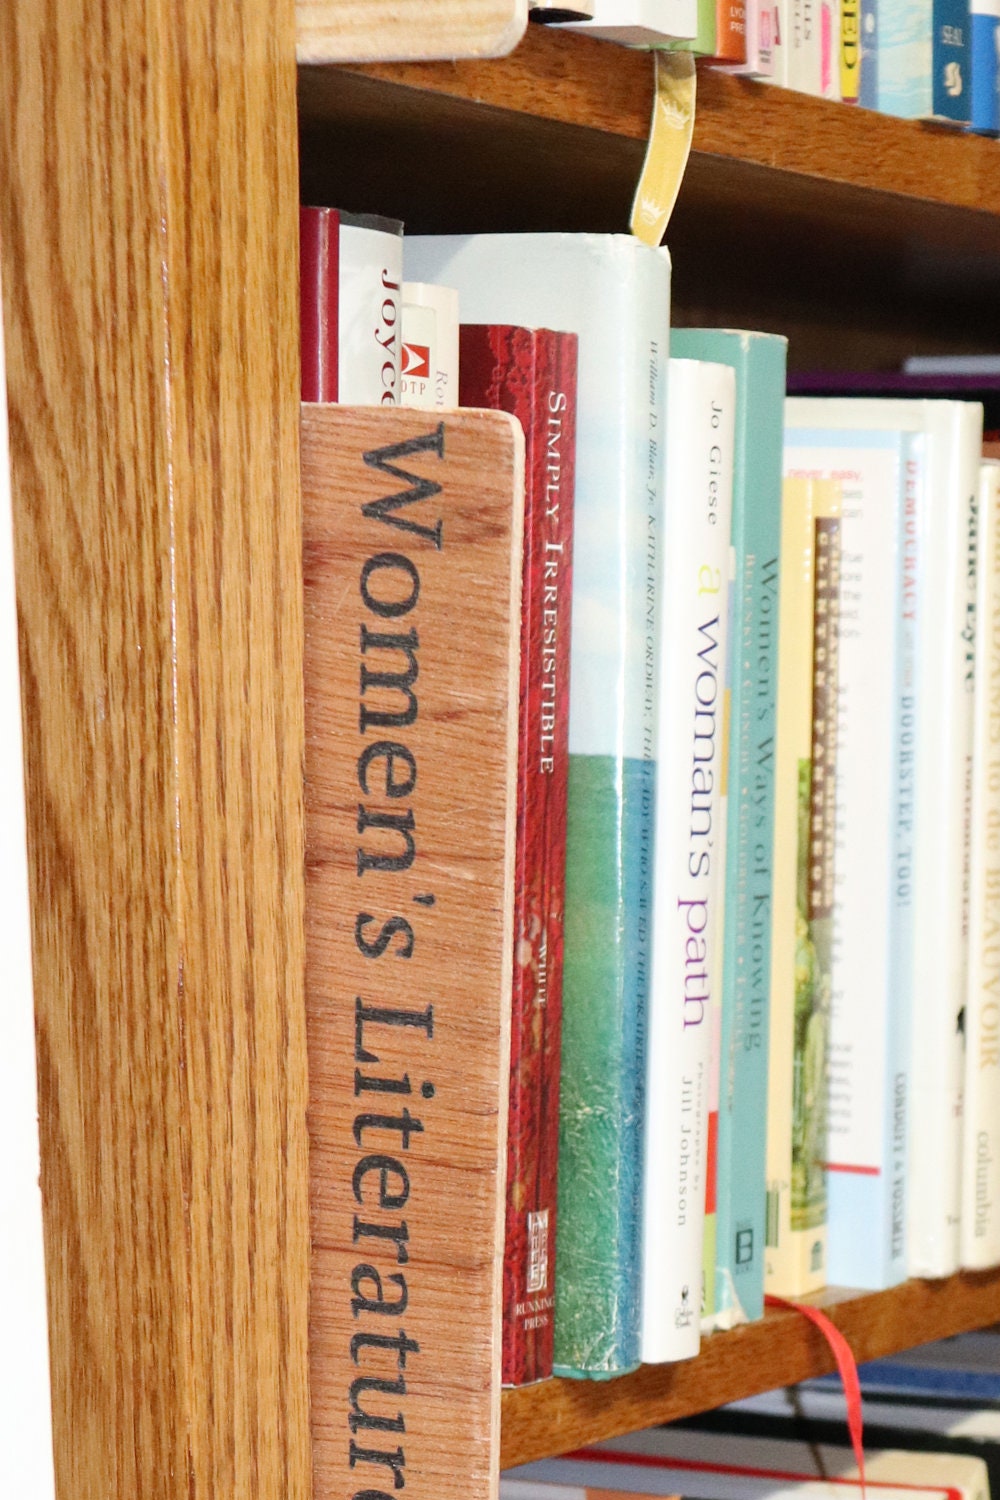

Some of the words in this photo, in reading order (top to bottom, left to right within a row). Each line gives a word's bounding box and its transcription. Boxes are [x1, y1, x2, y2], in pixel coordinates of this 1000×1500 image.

[707, 401, 723, 429] Jo
[706, 445, 723, 527] Giese
[697, 565, 721, 597] a
[355, 421, 447, 960] Women's
[757, 557, 778, 722] Women's
[688, 615, 721, 879] woman's
[751, 736, 774, 828] Ways
[754, 842, 771, 877] of
[677, 895, 712, 1033] path
[744, 892, 770, 1051] Knowing
[679, 1075, 694, 1114] Jill
[675, 1124, 693, 1229] Johnson
[973, 1130, 993, 1238] columbia
